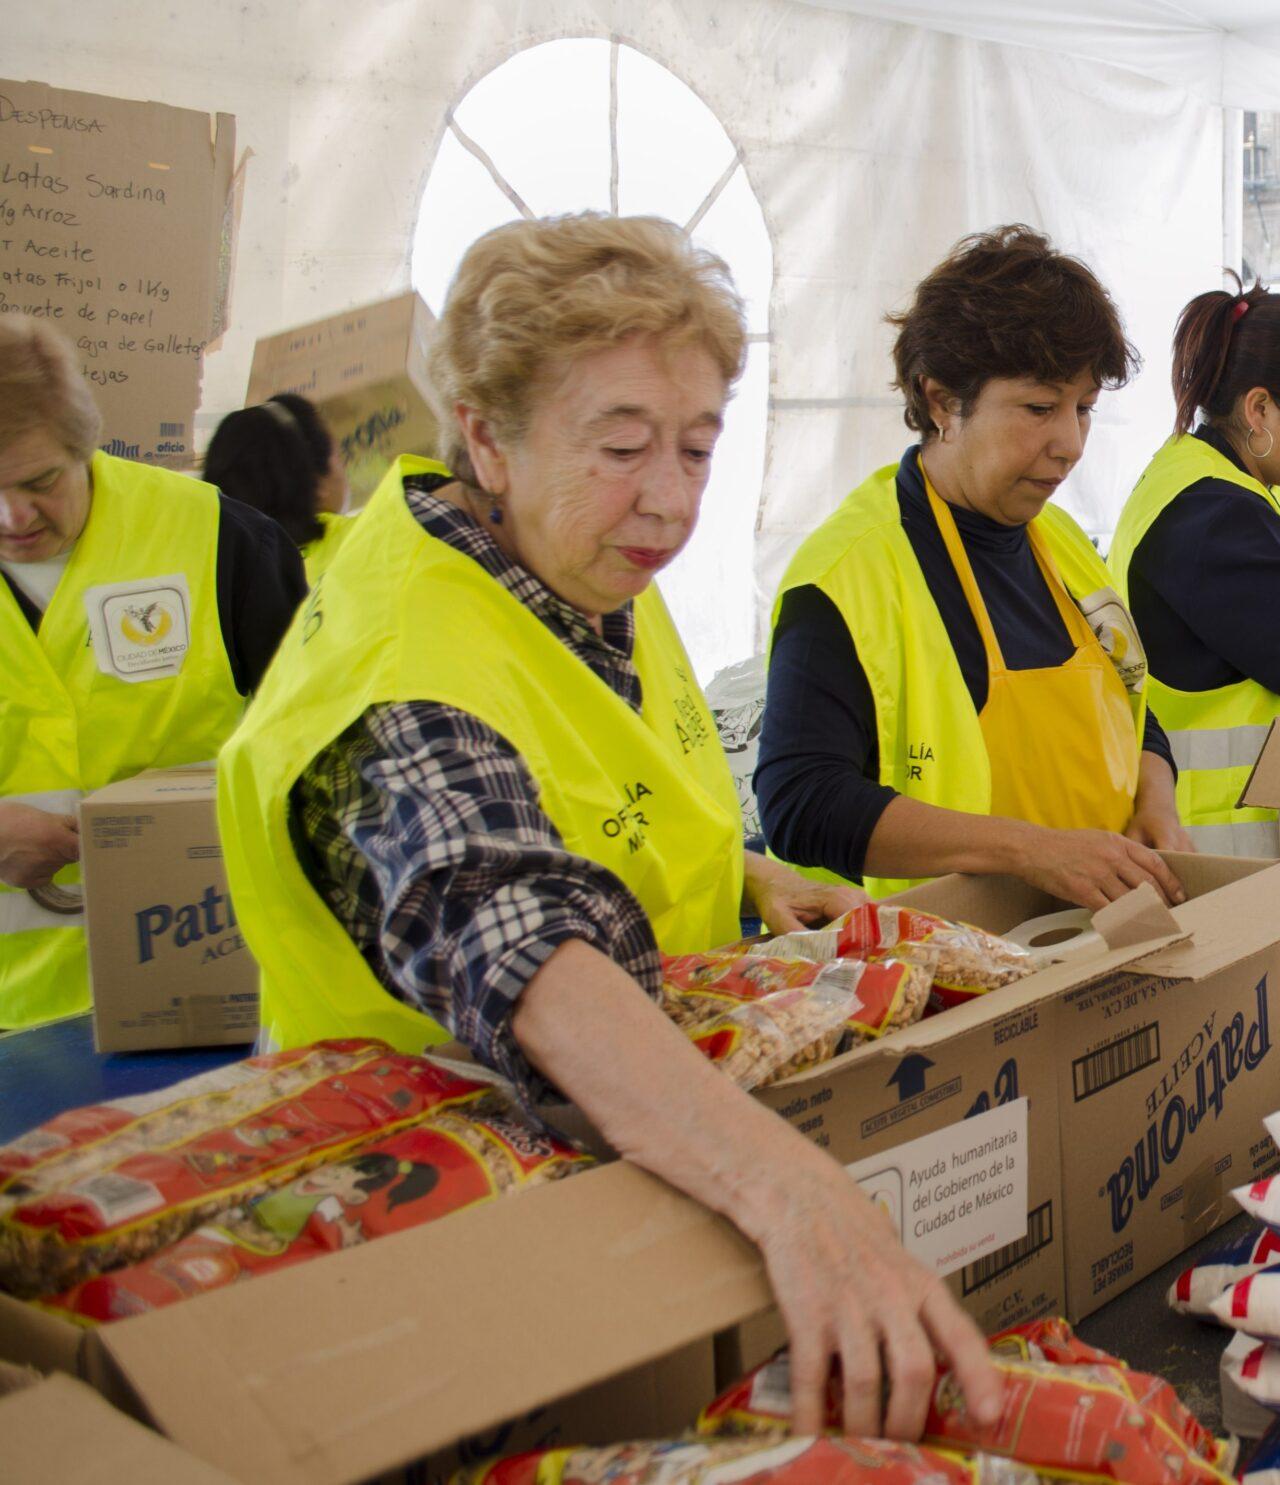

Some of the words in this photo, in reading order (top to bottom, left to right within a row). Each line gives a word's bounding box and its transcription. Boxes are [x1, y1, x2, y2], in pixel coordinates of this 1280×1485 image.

[0, 94, 107, 133] DESPENSA
[3, 162, 69, 194] Latas
[85, 173, 167, 205] Sardina
[22, 203, 81, 226] Arroz
[25, 239, 96, 263] Aceite
[78, 303, 97, 321] de
[118, 337, 136, 352] de
[993, 1012, 1040, 1048] RECICLABLE
[1145, 1009, 1217, 1120] ACEITE
[1106, 971, 1274, 1234] Patrona
[908, 1158, 946, 1191] Ayuda
[951, 1129, 1018, 1169] humanitaria
[912, 1191, 932, 1213] del
[933, 1168, 988, 1203] Gobierno
[988, 1159, 1004, 1178] de
[1004, 1154, 1015, 1172] la
[913, 1209, 956, 1239] Ciudad
[957, 1201, 973, 1220] de
[974, 1181, 1014, 1211] México
